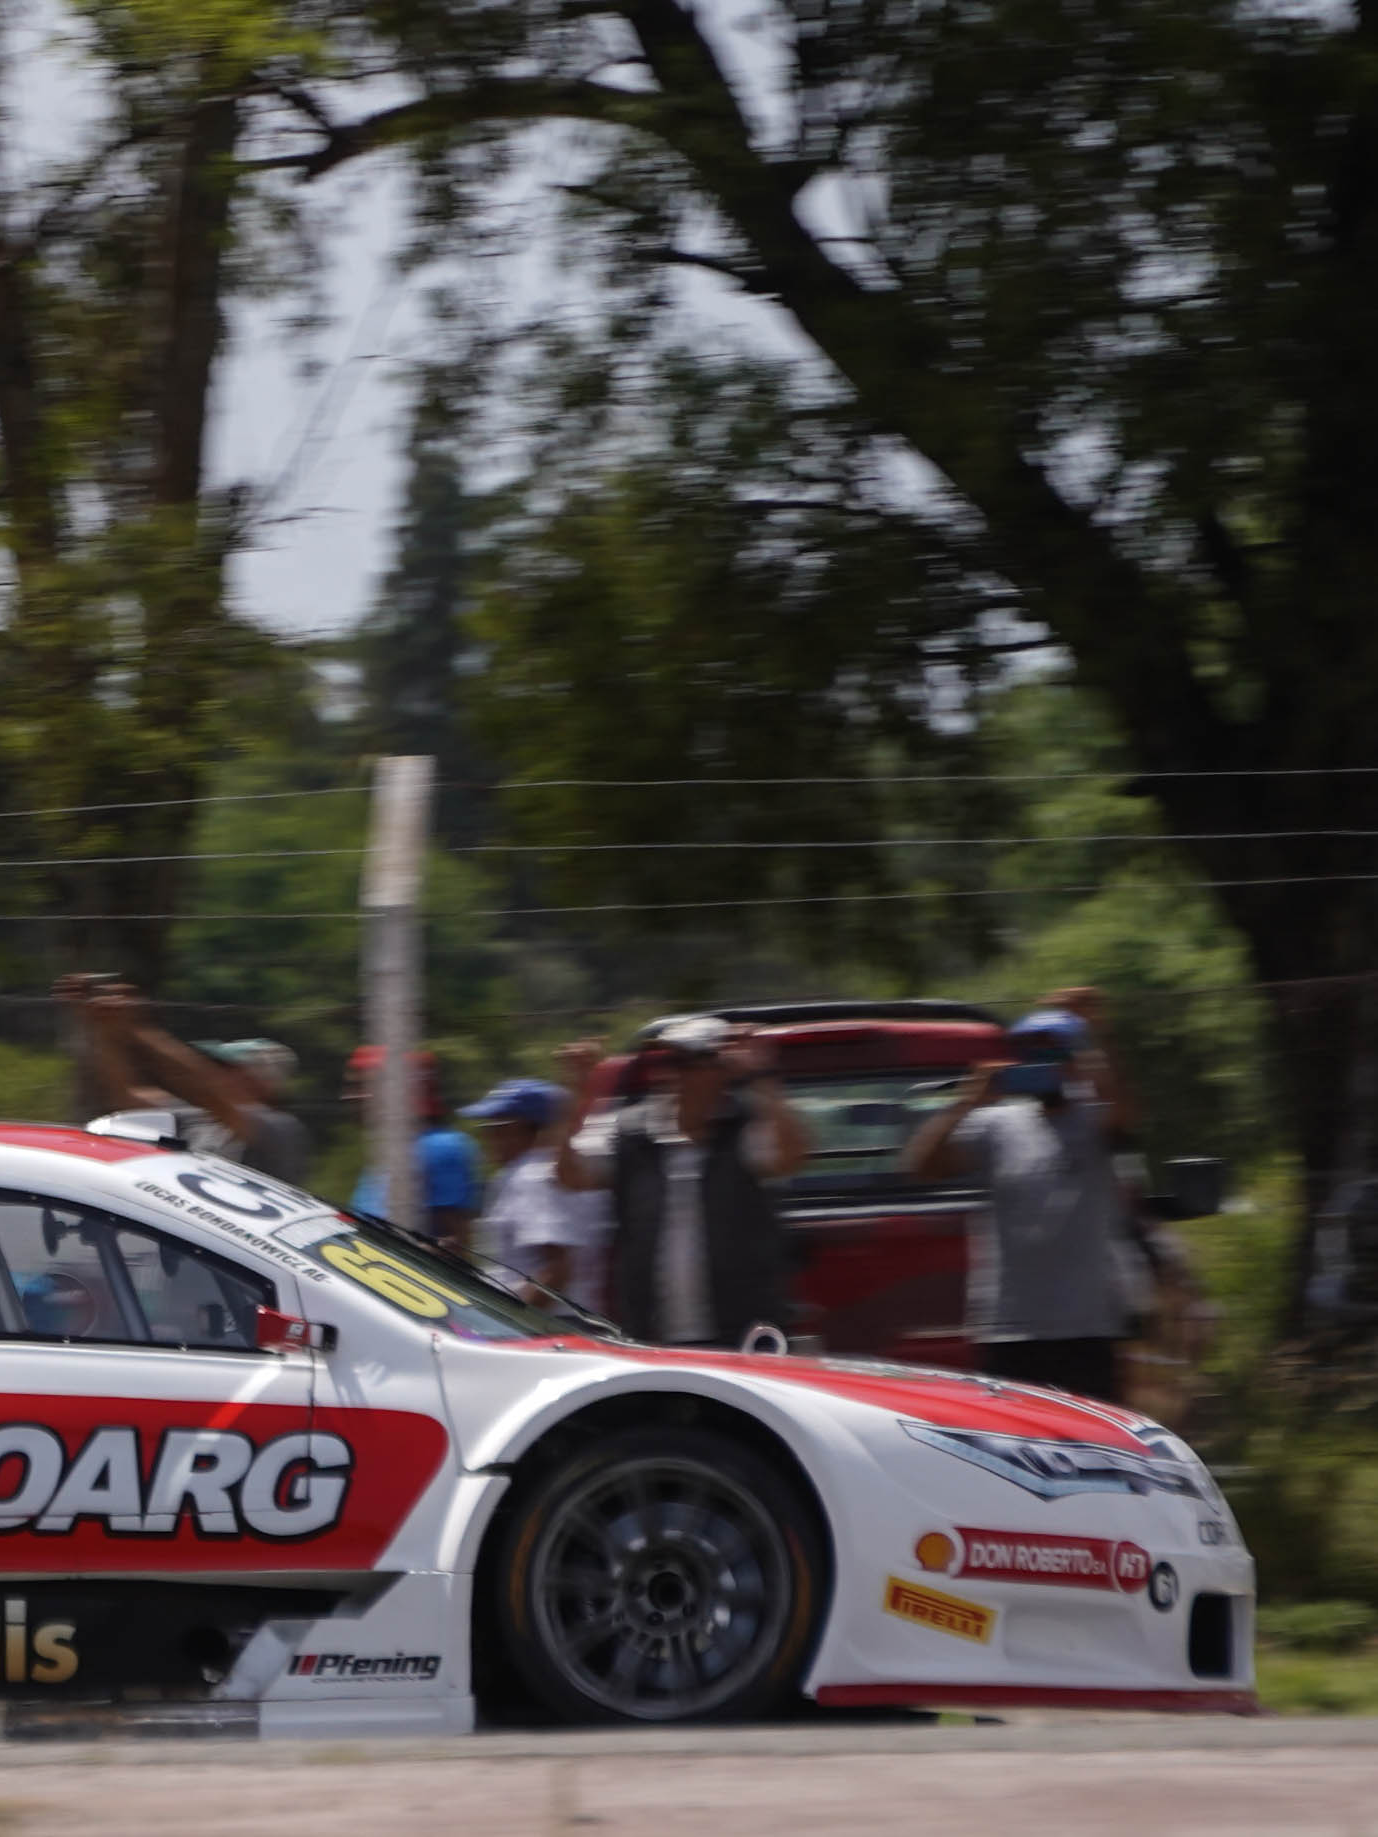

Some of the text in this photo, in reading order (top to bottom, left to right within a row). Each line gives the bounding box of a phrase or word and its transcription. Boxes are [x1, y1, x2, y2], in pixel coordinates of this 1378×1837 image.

[135, 1179, 191, 1209] LUCAS
[319, 1239, 472, 1320] 61
[970, 1542, 1013, 1569] DON
[1015, 1545, 1094, 1575] ROBERTO
[890, 1585, 989, 1638] PIRELLI
[315, 1651, 442, 1681] Pfening
